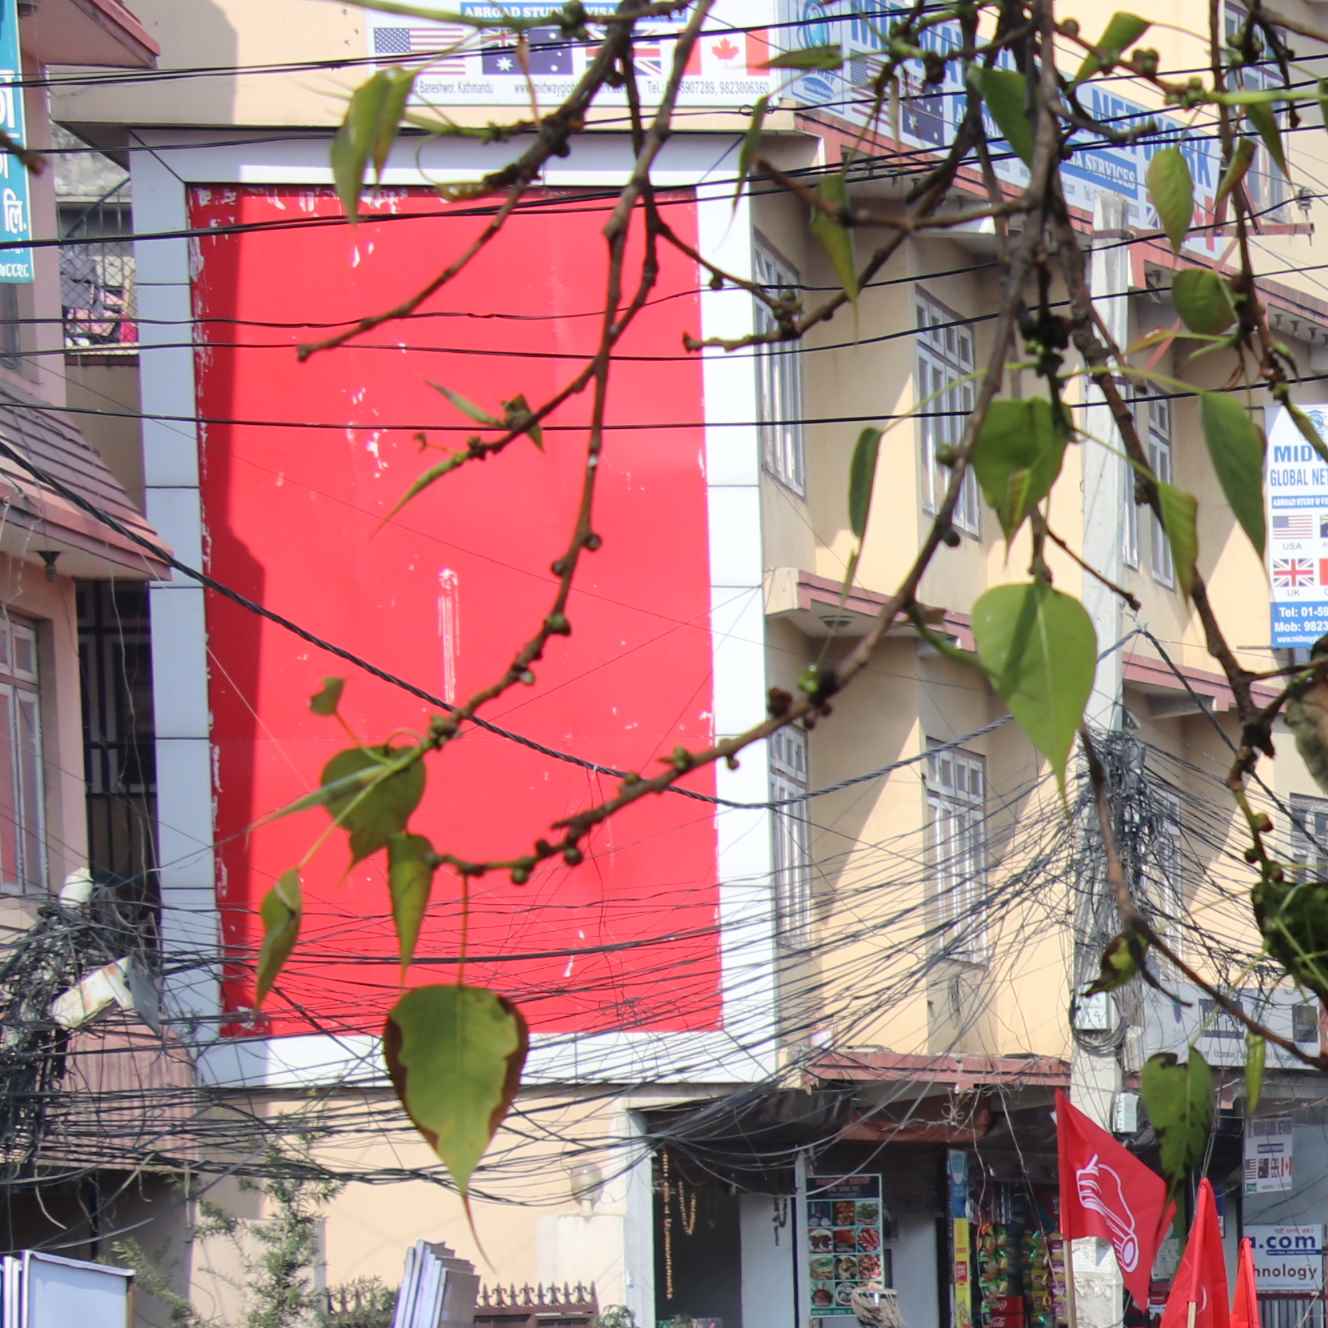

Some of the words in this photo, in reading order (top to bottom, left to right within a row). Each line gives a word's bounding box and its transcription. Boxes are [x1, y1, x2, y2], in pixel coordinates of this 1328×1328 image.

[464, 7, 517, 19] ABROAD
[1271, 467, 1308, 486] GLOBAL
[1282, 542, 1302, 551] USA
